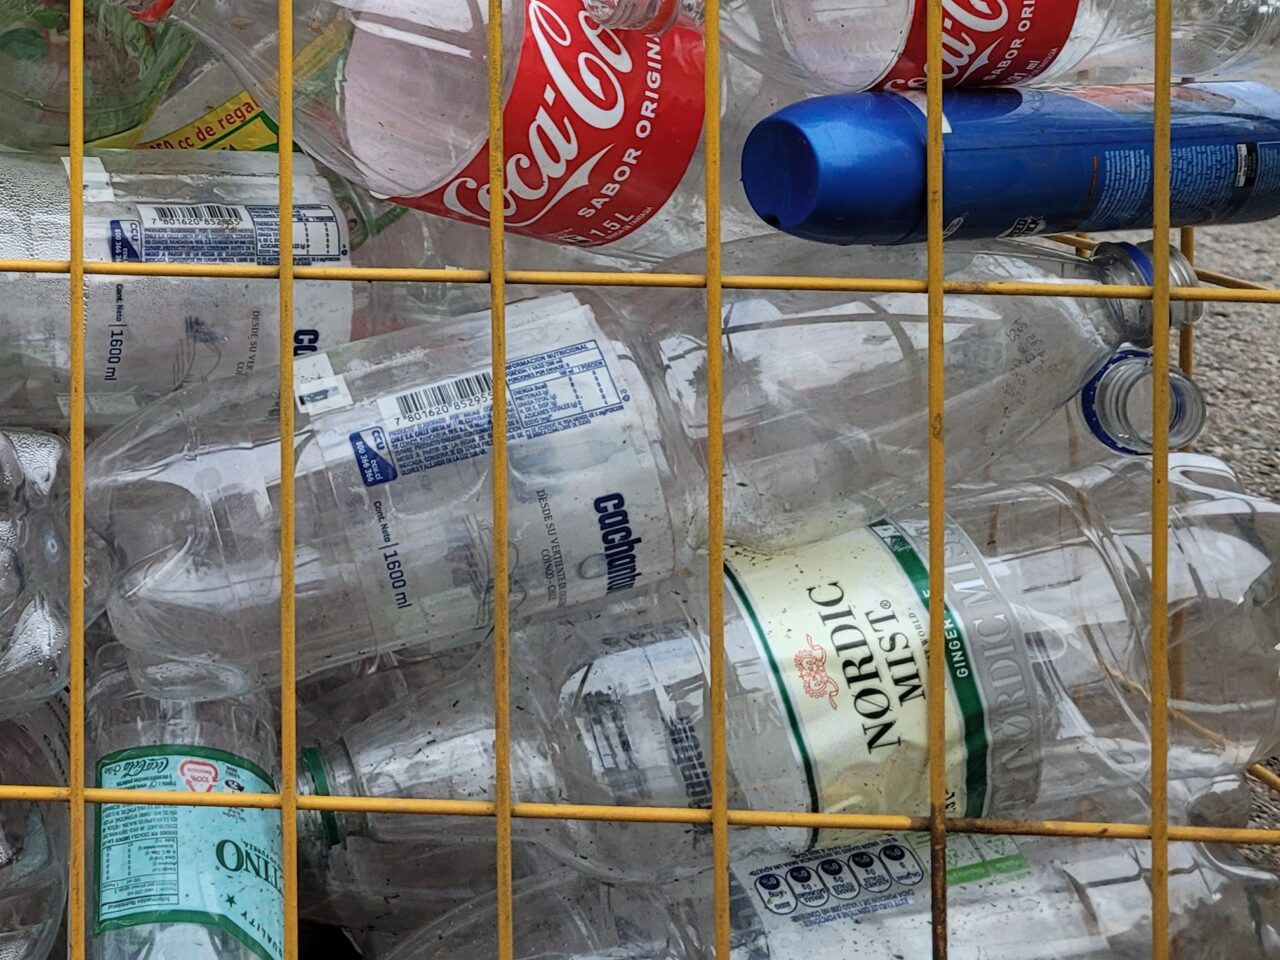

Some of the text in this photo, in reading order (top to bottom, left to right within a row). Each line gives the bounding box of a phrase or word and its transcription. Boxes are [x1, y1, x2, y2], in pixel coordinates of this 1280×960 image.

[983, 34, 1025, 81] SABOR
[193, 121, 217, 143] de
[578, 142, 643, 221] SABOR
[130, 223, 139, 242] CCU
[163, 217, 199, 228] 801620
[104, 283, 125, 381] Cont. Neto 1600 ml
[248, 310, 260, 353] DESDE SU
[546, 342, 588, 360] NUTRICIONAL
[394, 417, 401, 426] 7
[407, 404, 450, 423] 801620
[370, 428, 386, 451] CCU
[360, 453, 370, 468] 366
[364, 467, 374, 483] 366
[536, 489, 566, 582] DESDE SU VERTIENTE
[372, 500, 413, 610] Cont. Neto 1600 ml
[807, 579, 902, 755] NØRDIC
[865, 607, 928, 707] MIST
[121, 757, 169, 778] Coca-Cola
